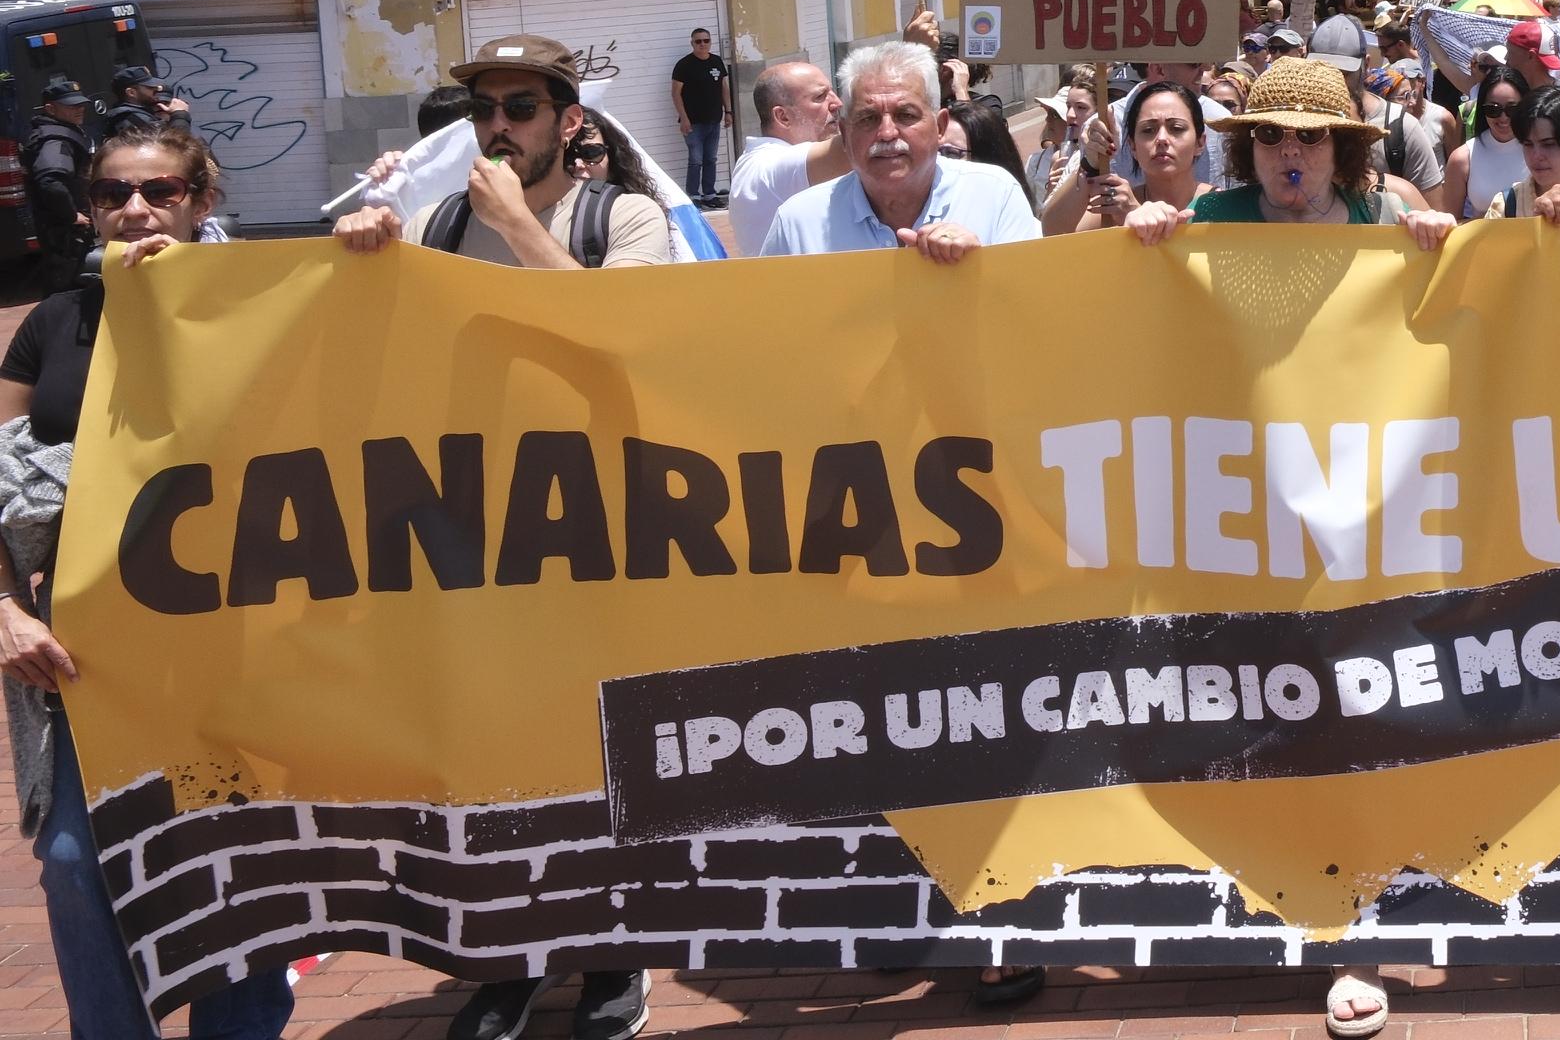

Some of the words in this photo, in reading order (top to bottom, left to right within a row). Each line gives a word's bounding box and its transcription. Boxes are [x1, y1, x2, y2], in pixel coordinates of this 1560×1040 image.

[118, 431, 1003, 615] CANARIAS
[1041, 416, 1463, 581] TIENE
[654, 699, 868, 779] ¡POR
[885, 682, 1006, 750] UN
[1021, 663, 1320, 733] CAMBIO
[1335, 644, 1443, 717] DE
